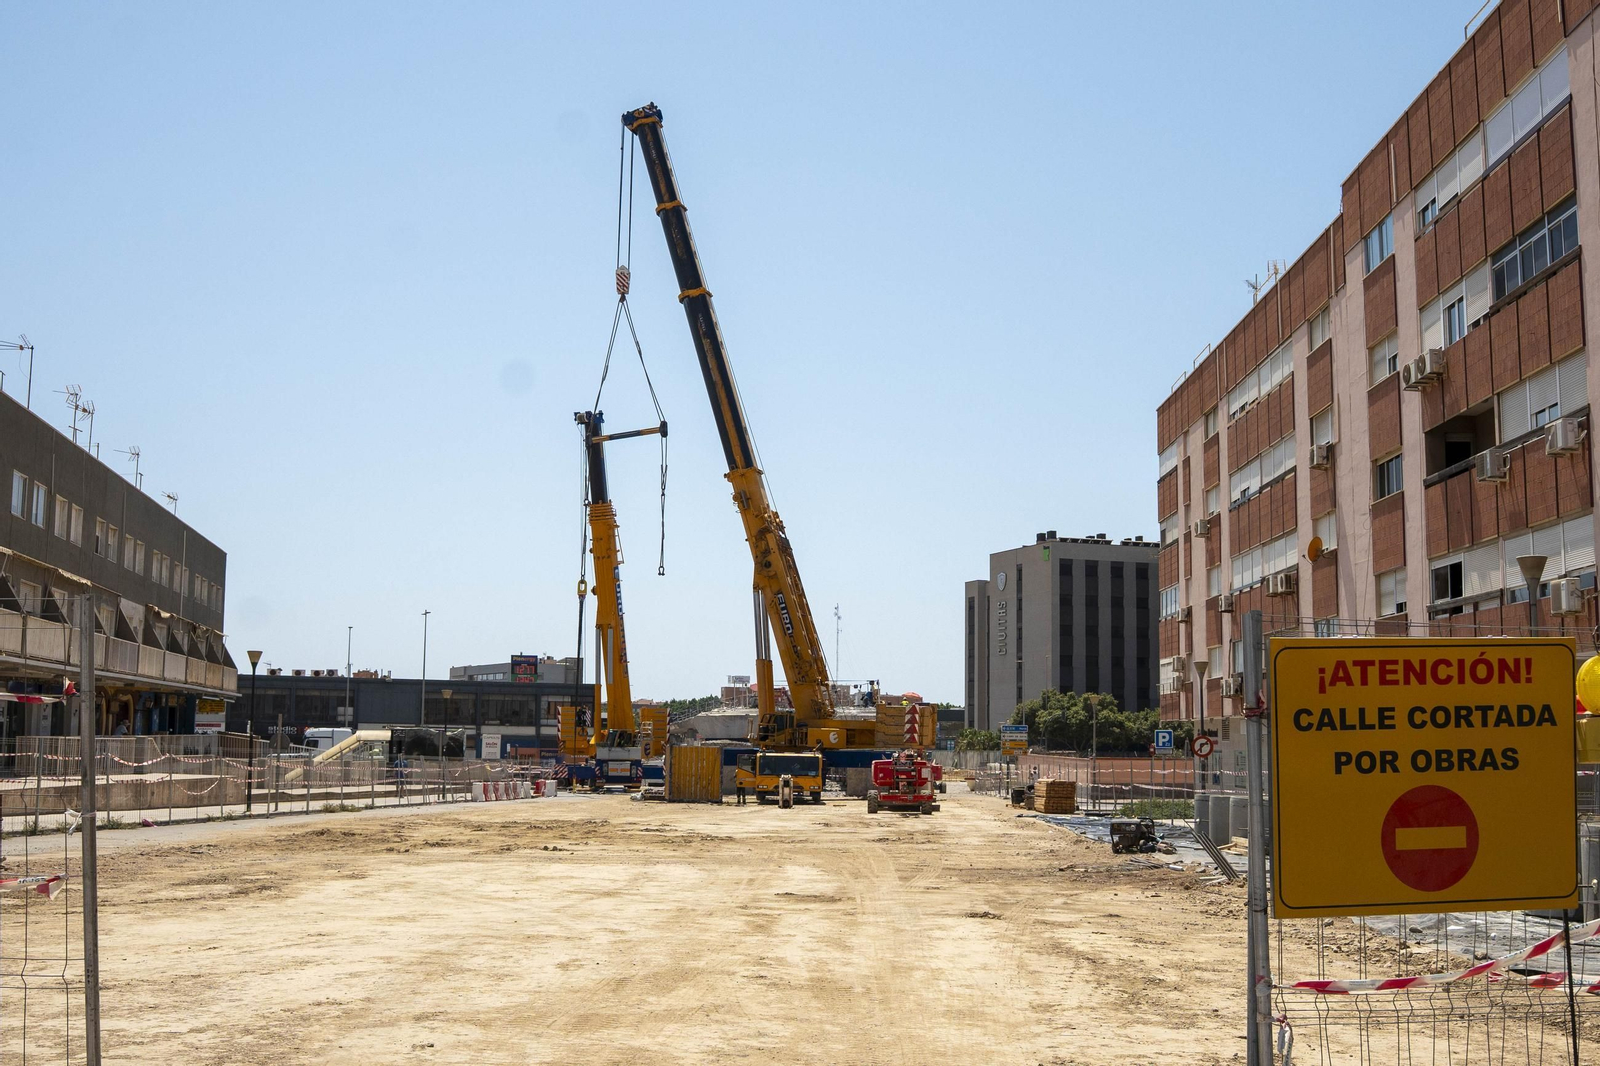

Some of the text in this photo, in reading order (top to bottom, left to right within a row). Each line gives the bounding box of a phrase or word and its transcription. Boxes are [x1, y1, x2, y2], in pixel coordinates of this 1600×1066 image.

[1318, 651, 1533, 694] ¡ATENCIÓN!
[1293, 704, 1559, 732] CALLE CORTADA
[1158, 732, 1170, 746] P
[1334, 747, 1520, 775] POR OBRAS
